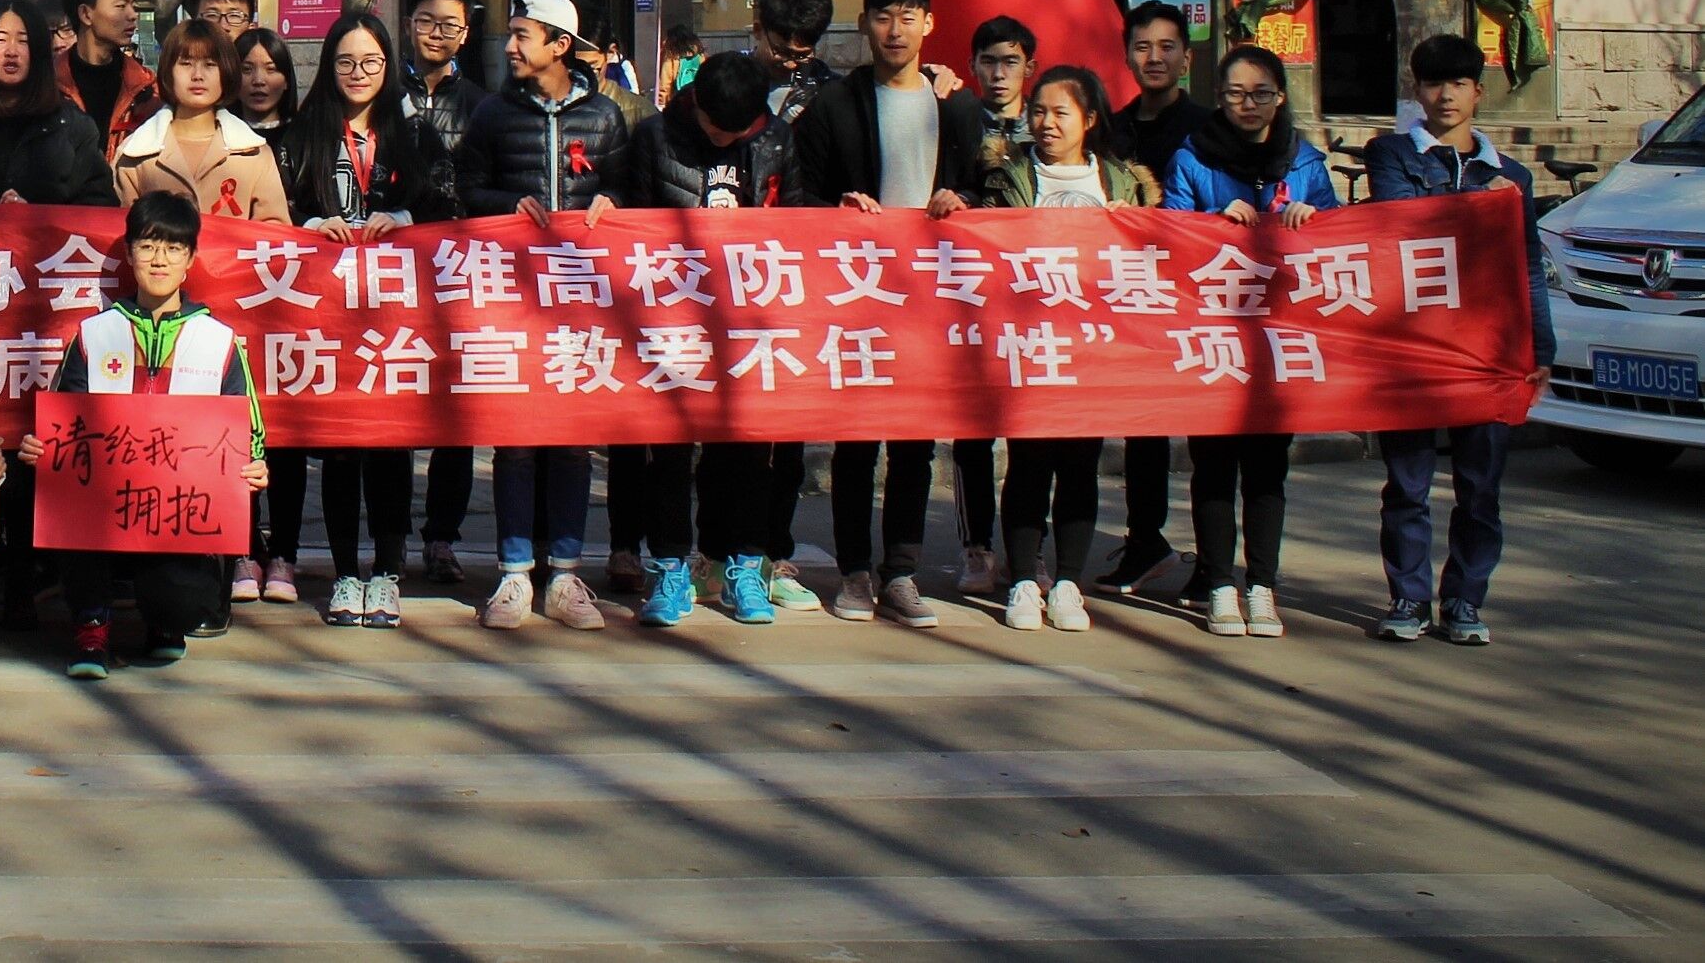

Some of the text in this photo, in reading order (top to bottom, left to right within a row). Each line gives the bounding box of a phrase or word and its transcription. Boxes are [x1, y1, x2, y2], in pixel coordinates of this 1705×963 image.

[46, 415, 249, 486] 请给我一个
[115, 484, 223, 537] 拥抱
